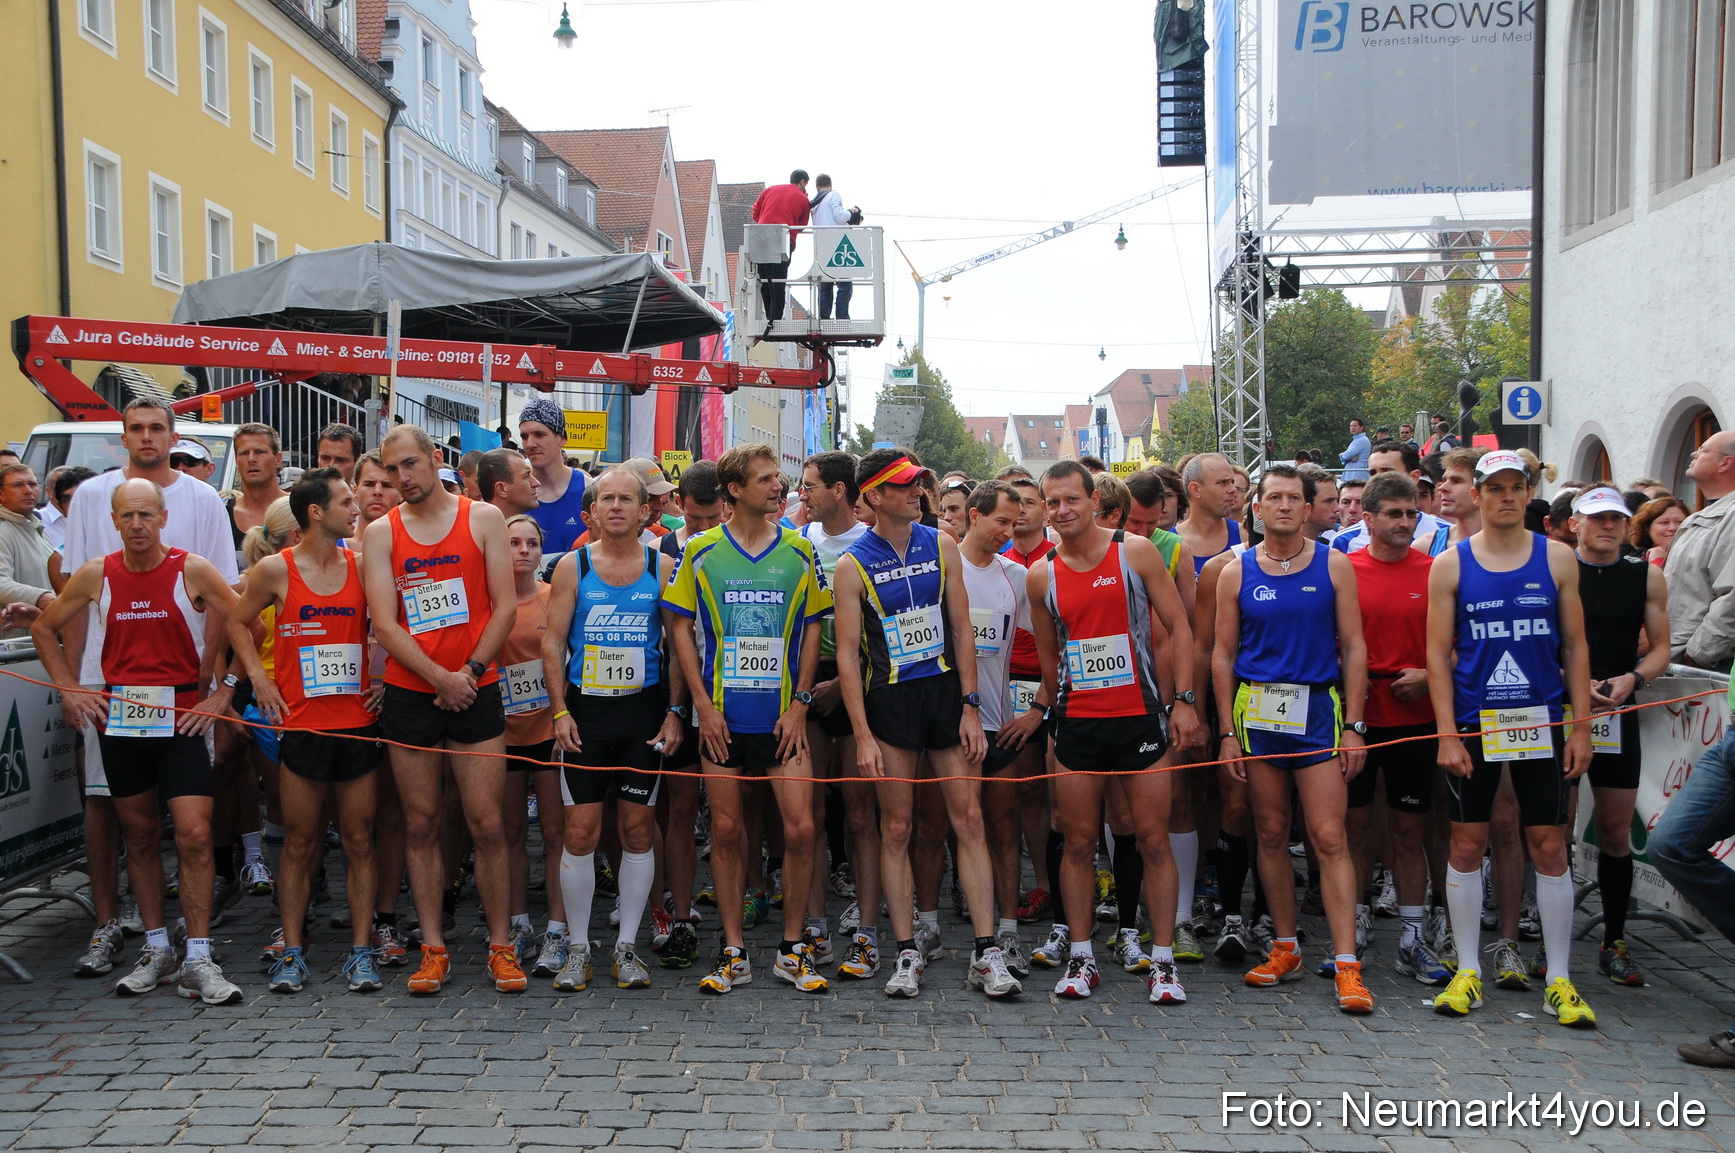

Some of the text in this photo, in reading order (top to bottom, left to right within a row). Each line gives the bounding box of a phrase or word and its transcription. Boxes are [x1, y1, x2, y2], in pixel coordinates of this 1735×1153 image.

[1362, 34, 1466, 47] Veranstaltungs-
[1472, 32, 1497, 44] und
[73, 329, 112, 345] Jura
[118, 331, 195, 349] Gebäude
[200, 336, 260, 352] Service
[296, 342, 334, 356] Miet-
[338, 346, 349, 357] &
[353, 345, 433, 362] Servieline:
[437, 350, 475, 364] 09181
[652, 366, 684, 379] 6352
[570, 432, 587, 440] lauf
[664, 452, 688, 461] Block
[670, 463, 680, 480] A
[1113, 464, 1138, 473] Block
[404, 554, 461, 573] CONRAD
[869, 558, 898, 570] TEAM
[873, 560, 939, 585] BOCK
[417, 583, 443, 595] Stefan
[422, 592, 460, 612] 3318
[724, 591, 785, 604] BOCK
[131, 600, 151, 610] DAV
[1476, 600, 1504, 610] FESER
[116, 610, 168, 621] Röthenbach
[300, 605, 356, 620] CONRAD
[593, 615, 650, 626] NAGEL
[899, 615, 925, 629] Marco
[584, 632, 648, 642] TSG 08 Roth
[903, 625, 940, 646] 2001
[739, 640, 769, 651] Michael
[1082, 643, 1107, 654] Oliver
[318, 649, 343, 659] Marco
[599, 650, 625, 661] Dieter
[321, 663, 357, 677] 3315
[740, 657, 778, 672] 2002
[1085, 655, 1126, 673] 2000
[510, 668, 526, 680] Anja
[605, 666, 635, 681] 119
[513, 677, 547, 695] 3316
[1264, 685, 1300, 699] Wolfgang
[126, 690, 149, 700] Erwin
[127, 705, 167, 719] 2870
[1276, 701, 1287, 716] 4
[1498, 713, 1528, 724] Dorian
[1507, 727, 1540, 743] 903
[628, 787, 649, 796] asics
